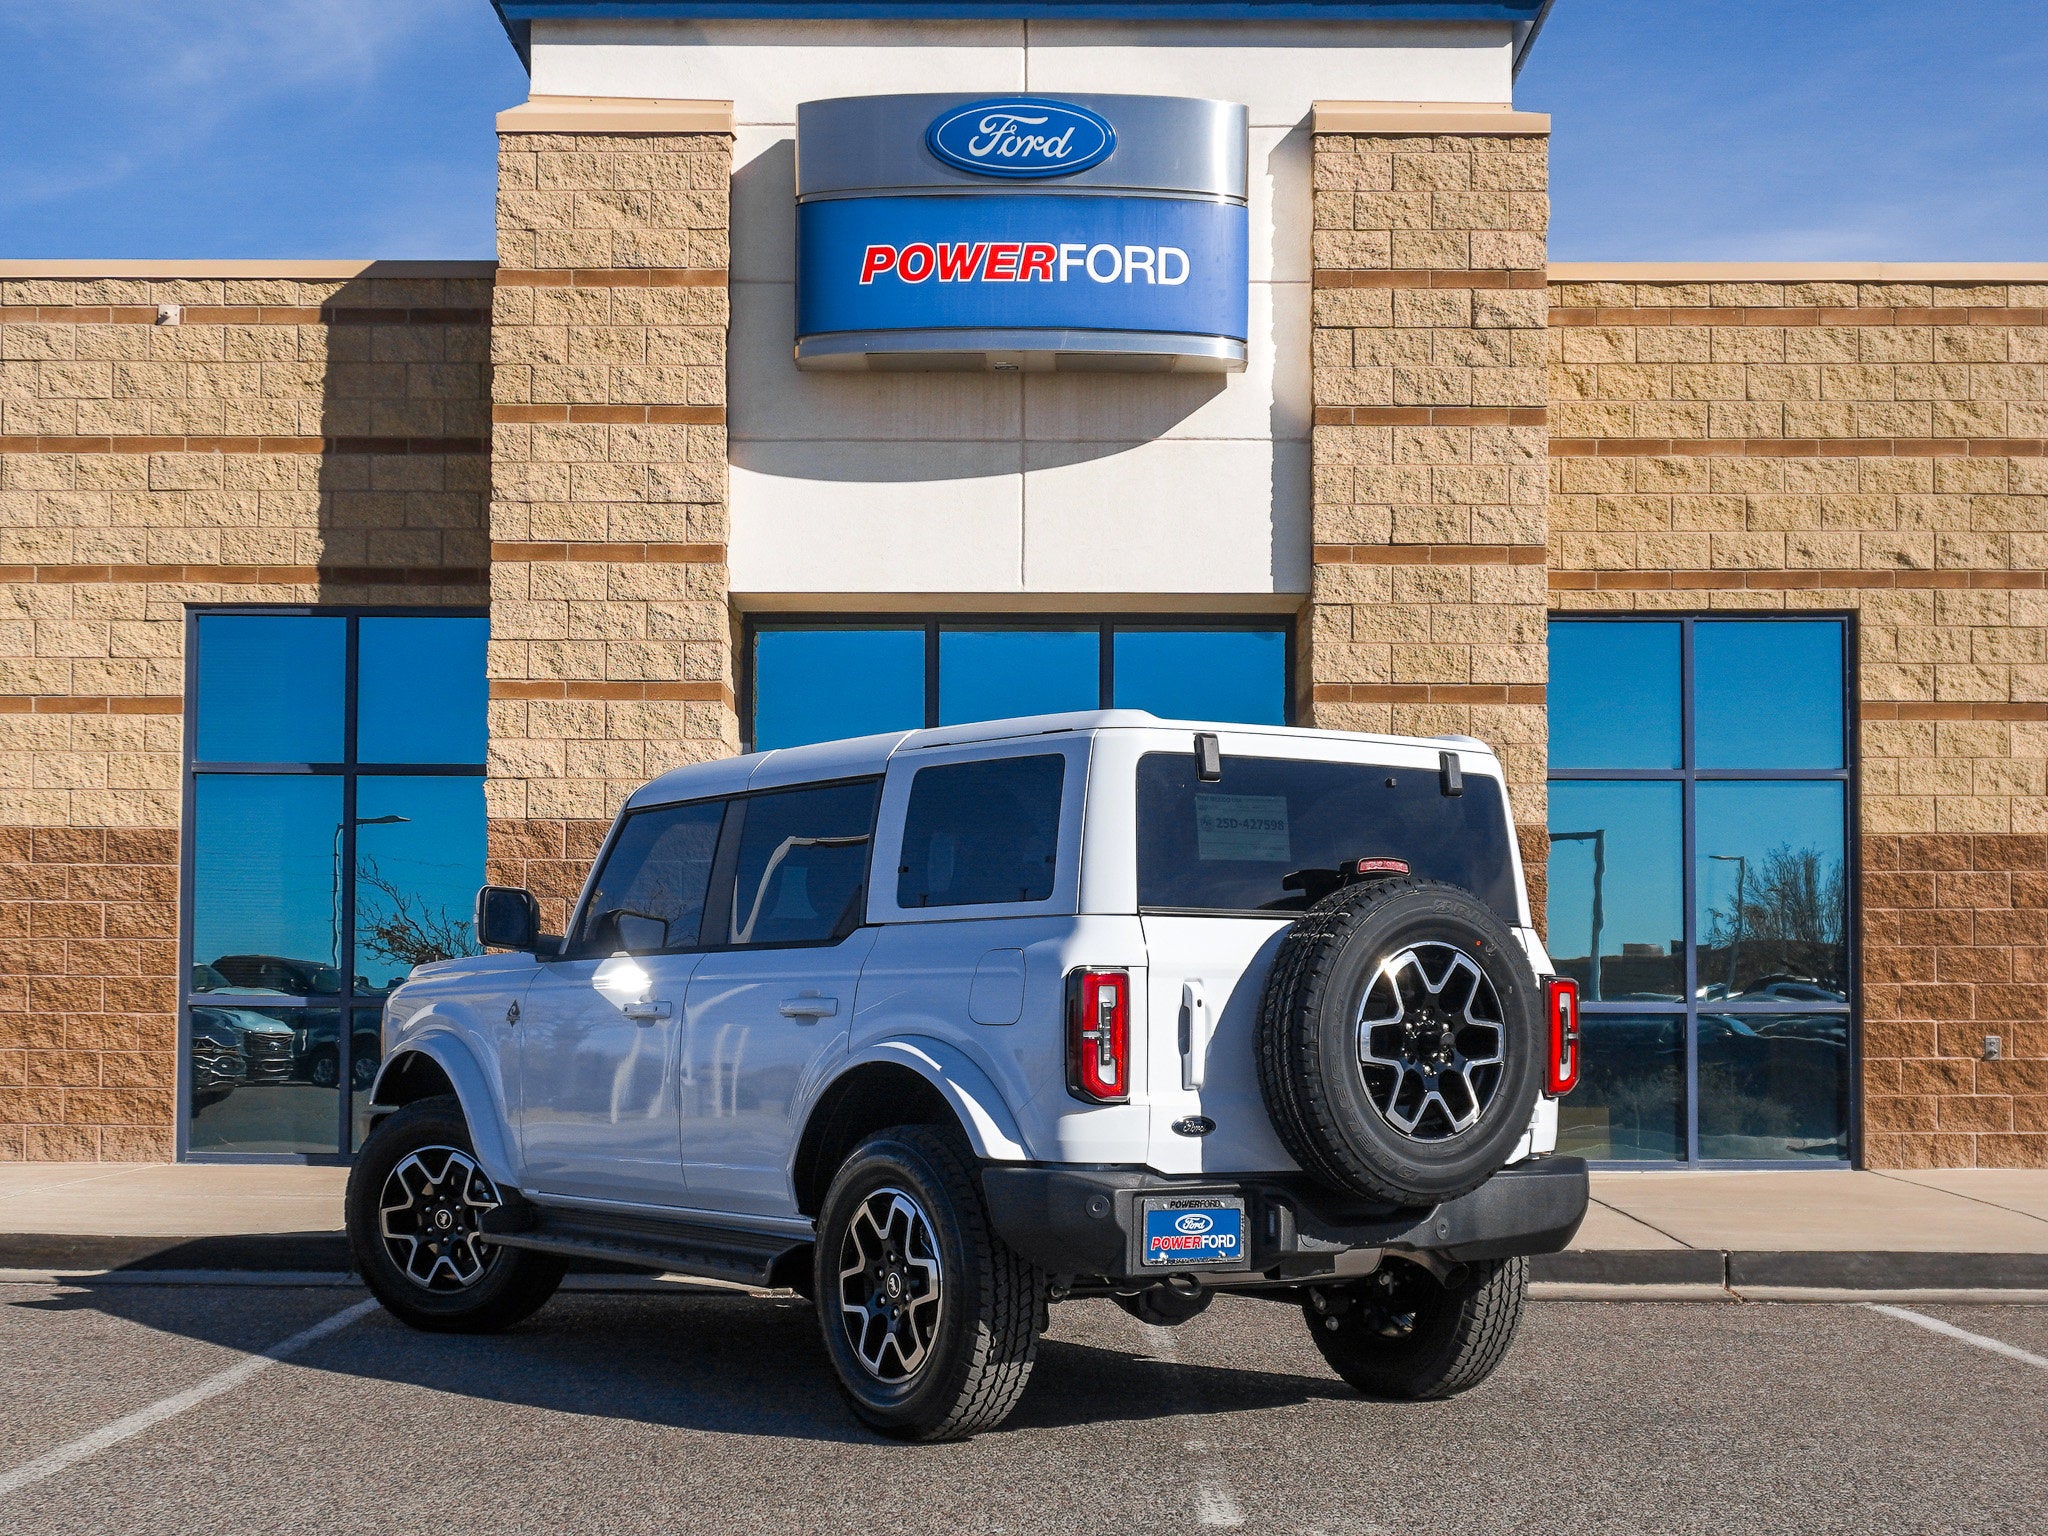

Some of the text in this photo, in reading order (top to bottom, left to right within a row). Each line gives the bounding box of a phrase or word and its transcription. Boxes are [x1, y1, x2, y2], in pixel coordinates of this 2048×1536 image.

[968, 113, 1073, 159] Ford
[859, 242, 1191, 286] POWERFORD
[1170, 1200, 1221, 1209] POWERFORD
[1182, 1217, 1205, 1230] Ford
[1151, 1234, 1236, 1250] POWERFORD
